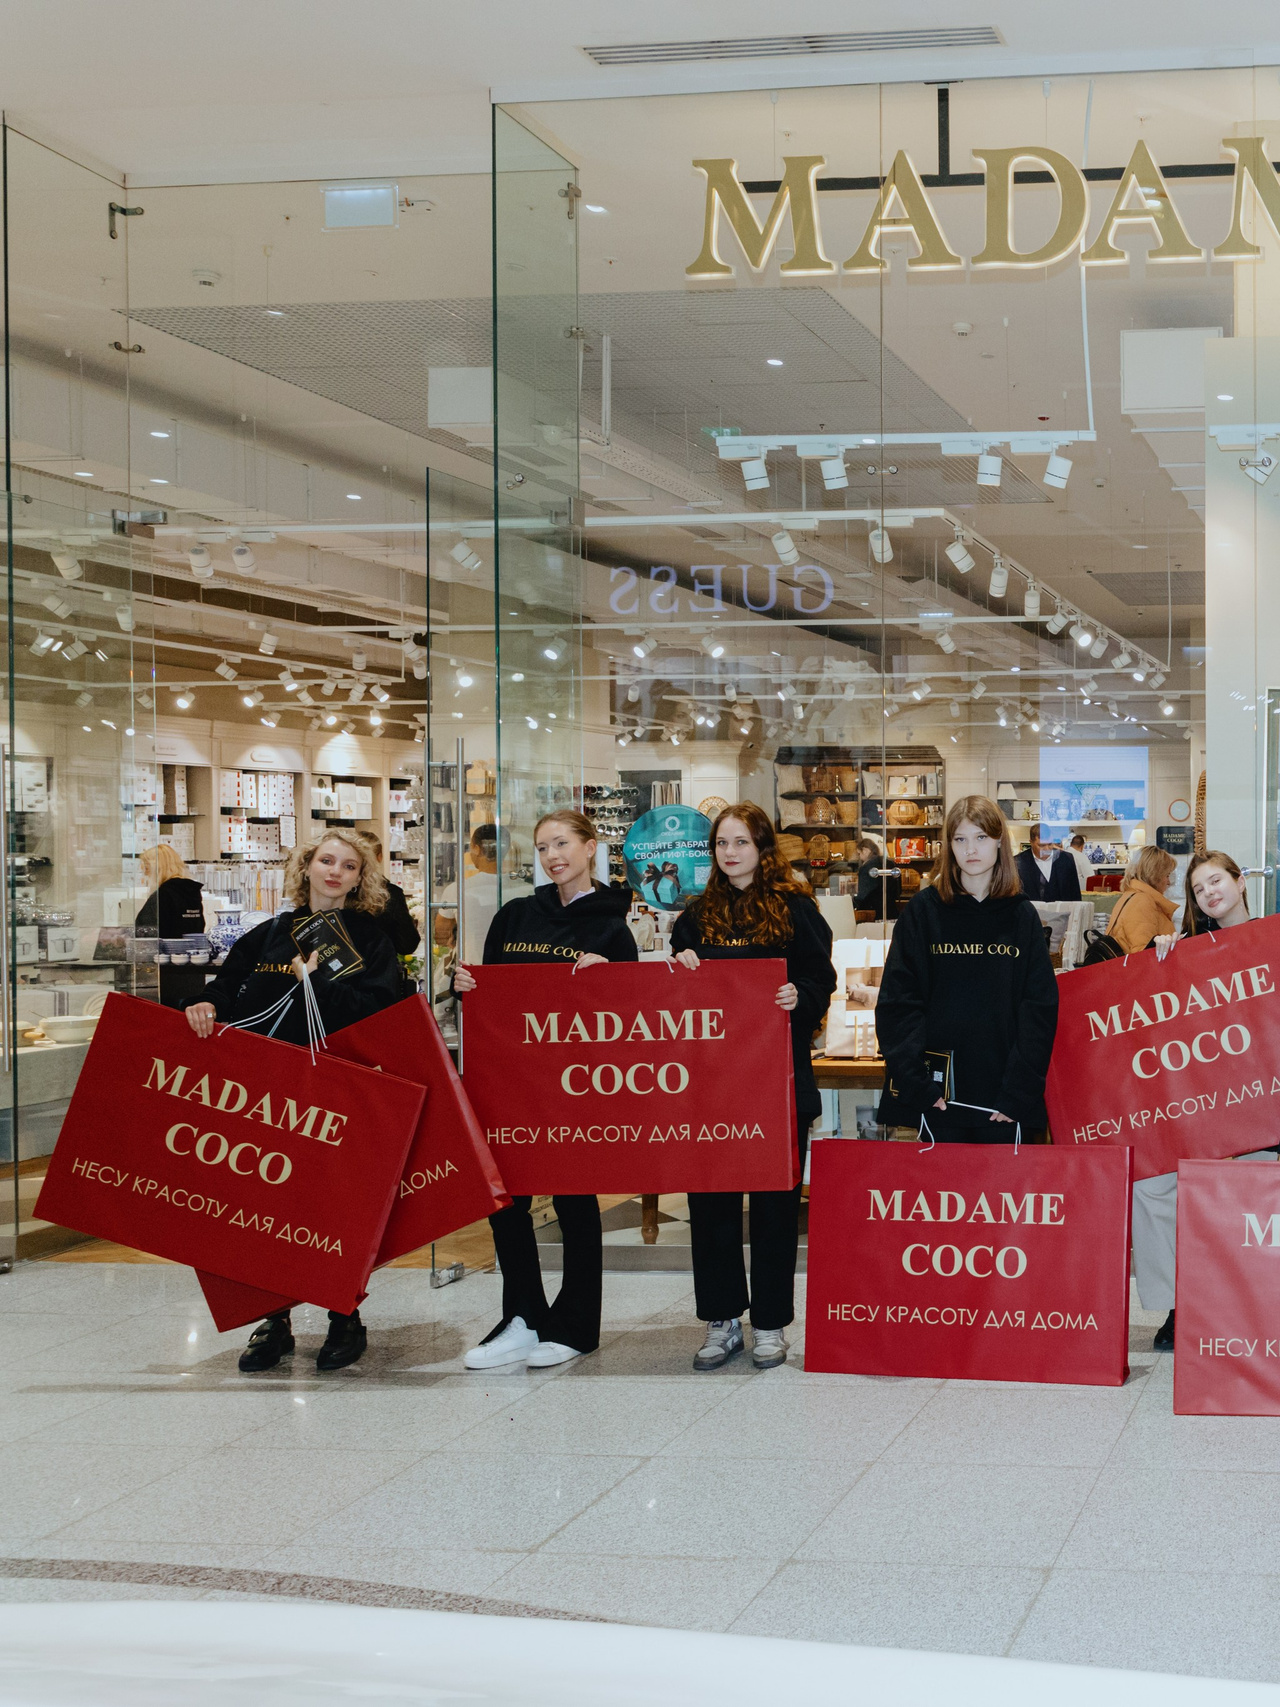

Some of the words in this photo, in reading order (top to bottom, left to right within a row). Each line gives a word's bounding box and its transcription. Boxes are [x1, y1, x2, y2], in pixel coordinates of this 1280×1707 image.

[632, 841, 673, 850] УСПЕЙТЕ
[675, 840, 710, 848] ЗАБРАТ
[634, 851, 660, 860] СВОЙ
[553, 946, 584, 960] COC
[1085, 964, 1275, 1041] MADAME
[522, 1009, 726, 1043] MADAME
[1132, 1024, 1251, 1079] COCO
[561, 1062, 689, 1095] COCO
[142, 1057, 347, 1146] MADAME
[1073, 1117, 1122, 1144] НЕСУ
[1129, 1091, 1217, 1129] КРАСОТУ
[1226, 1080, 1264, 1107] ДЛЯ
[487, 1127, 540, 1144] НЕСУ
[548, 1125, 642, 1143] КРАСОТУ
[649, 1124, 690, 1142] ДЛЯ
[697, 1123, 765, 1142] ДОМА
[165, 1122, 292, 1184] COCO
[400, 1159, 458, 1198] ДОМА
[72, 1157, 129, 1187] НЕСУ
[132, 1176, 228, 1218] КРАСОТУ
[229, 1209, 274, 1234] ДЛЯ
[276, 1222, 343, 1256] ДОМА
[867, 1189, 1065, 1225] MADAME
[902, 1243, 1027, 1279] COCO
[828, 1304, 880, 1322] НЕСУ
[886, 1306, 979, 1326] КРАСОТУ
[984, 1310, 1025, 1328] ДЛЯ
[1031, 1311, 1098, 1331] ДОМА
[1200, 1338, 1258, 1357] НЕСУ
